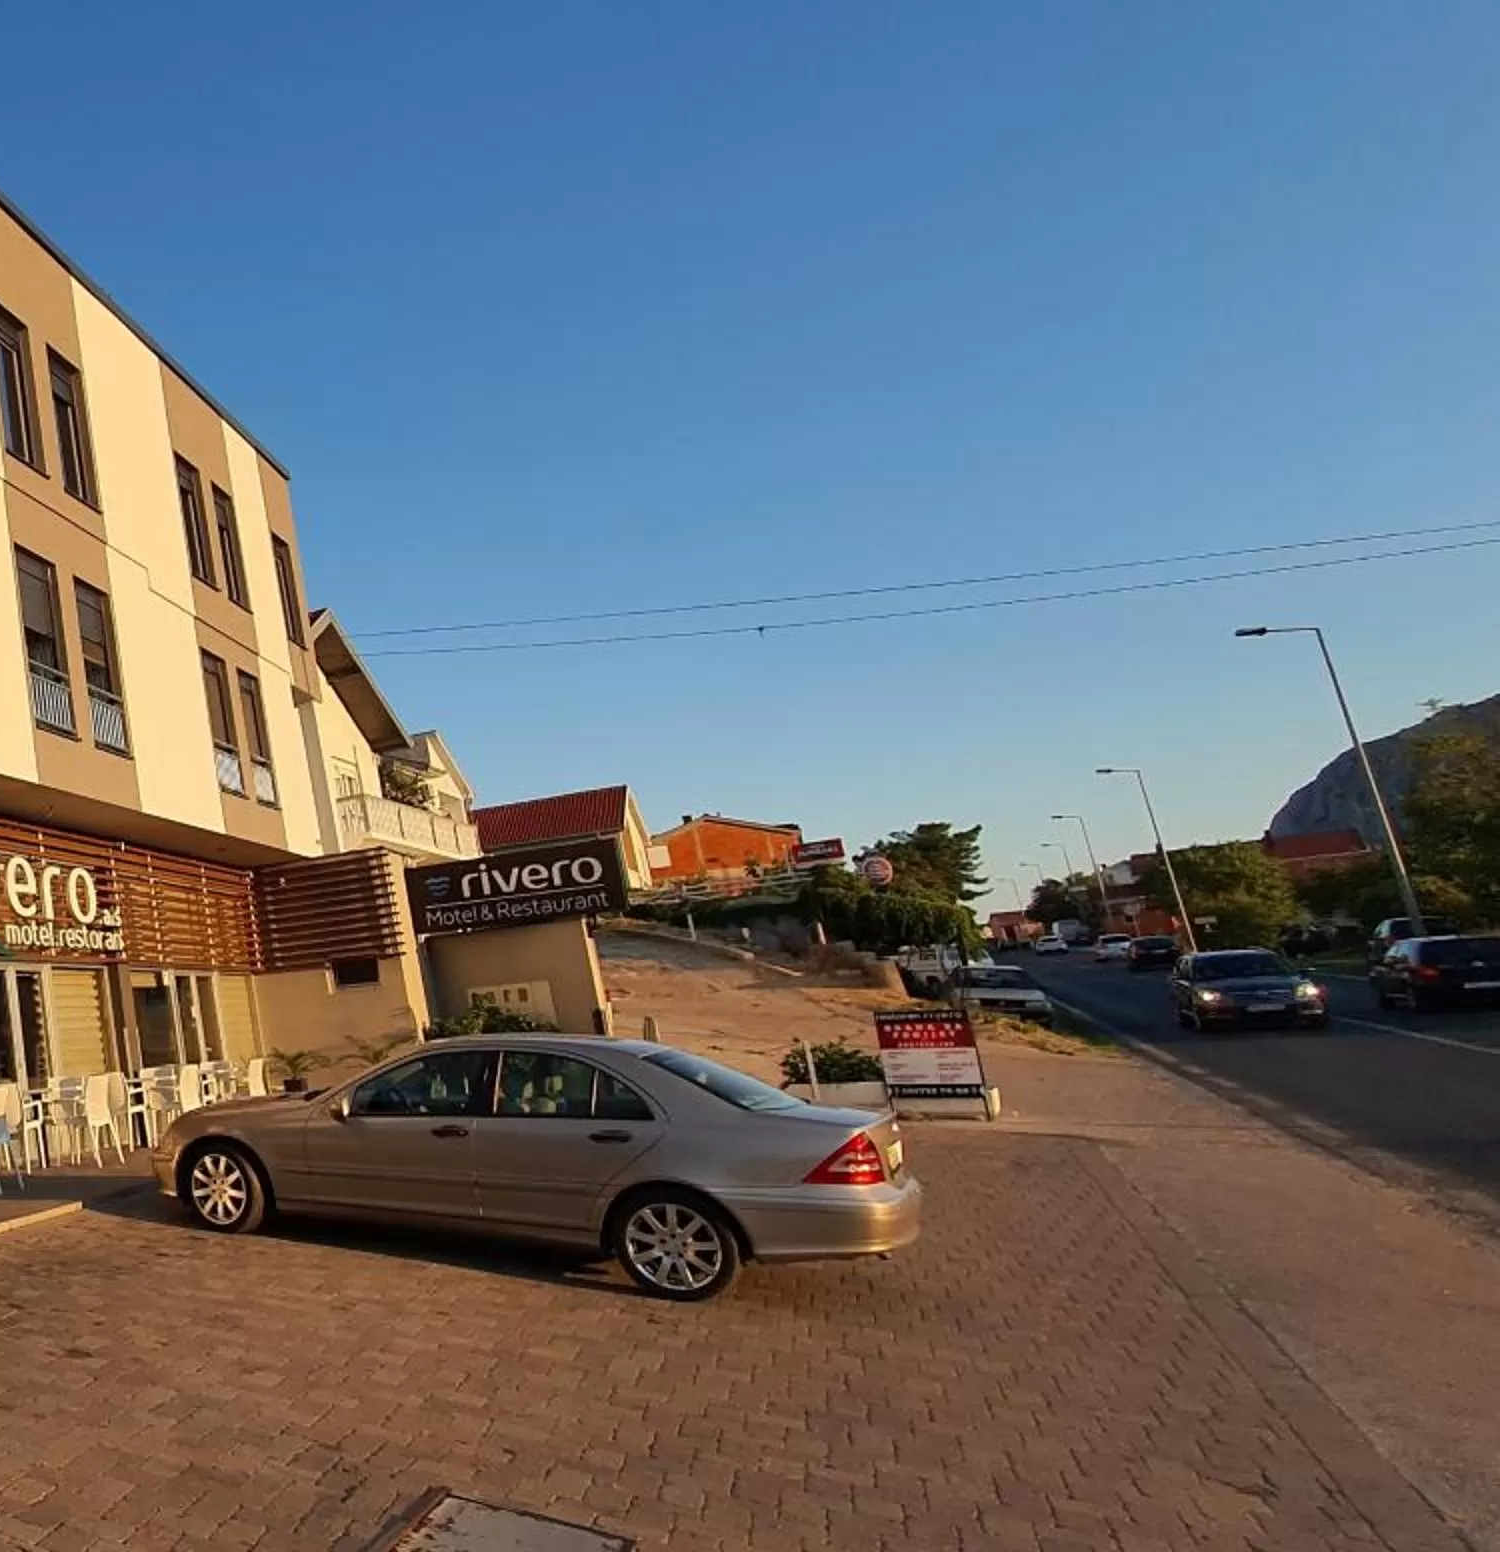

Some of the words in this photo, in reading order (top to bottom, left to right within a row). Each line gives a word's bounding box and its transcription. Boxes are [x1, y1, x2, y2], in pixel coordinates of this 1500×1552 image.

[461, 857, 602, 898] rivero
[426, 906, 477, 927] Motel
[480, 904, 494, 920] &
[496, 891, 609, 919] Restaurant
